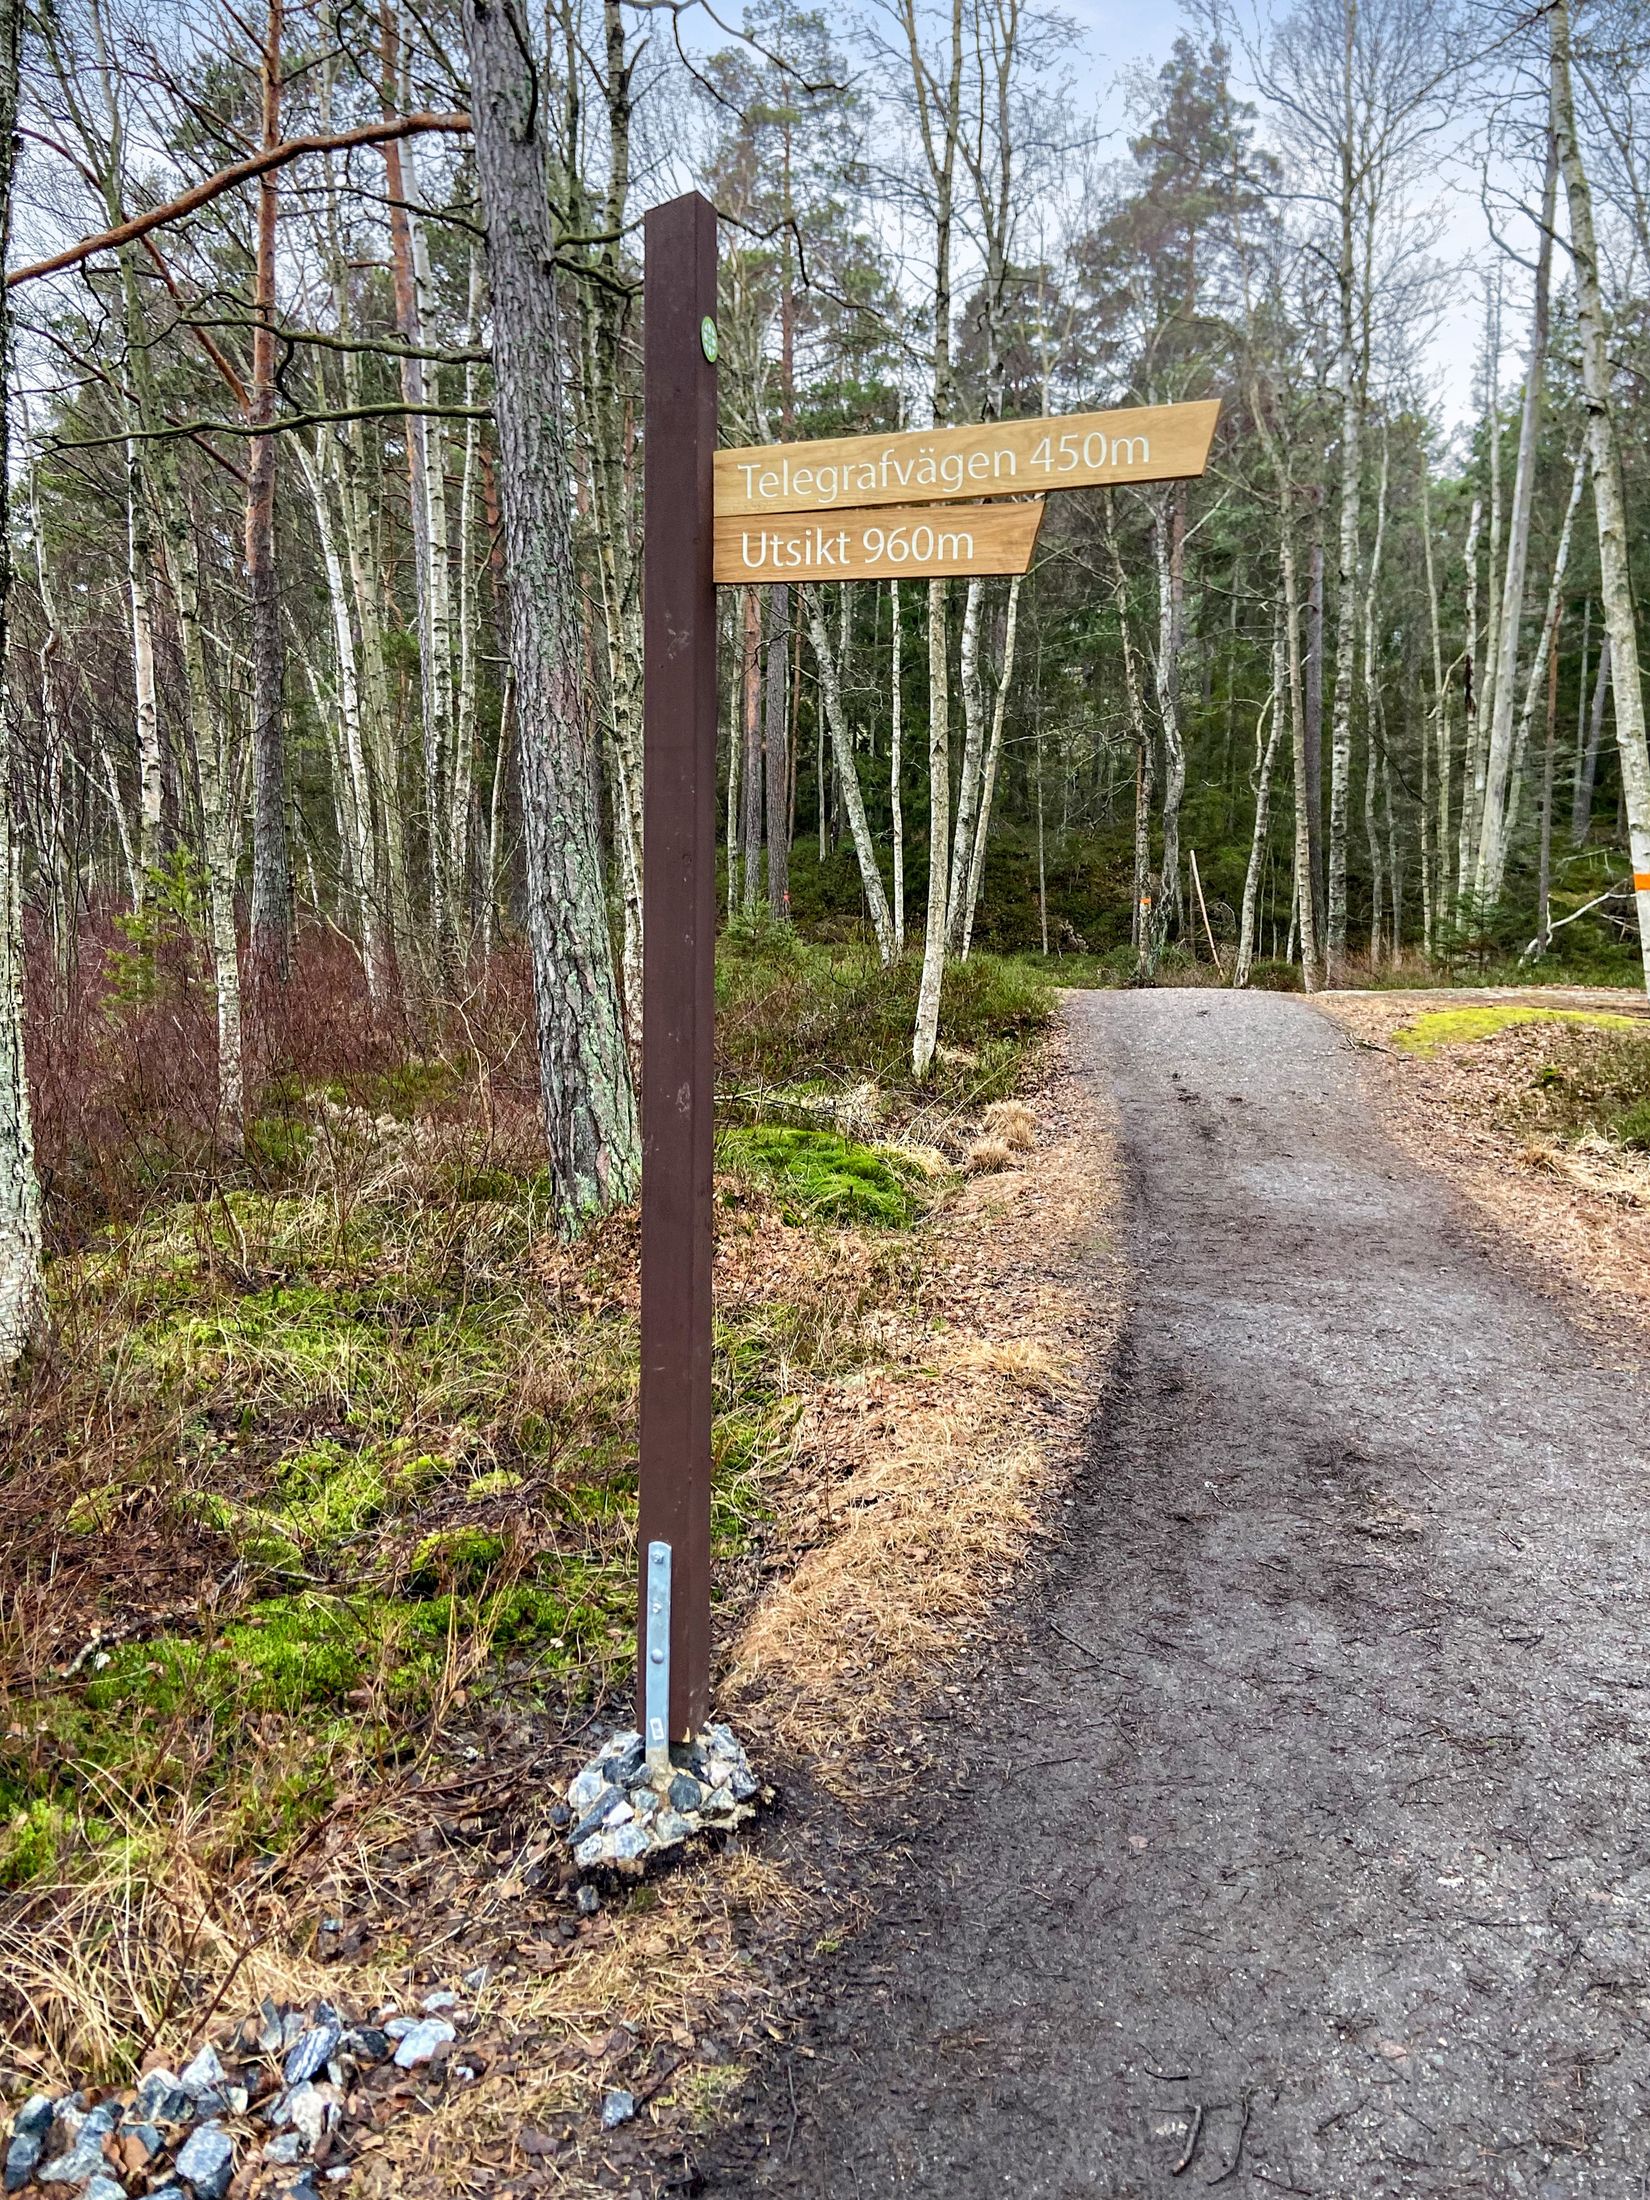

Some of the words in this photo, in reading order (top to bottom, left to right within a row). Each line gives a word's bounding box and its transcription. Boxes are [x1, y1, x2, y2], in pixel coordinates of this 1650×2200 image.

[737, 449, 1017, 502] Telegrafvägen
[1030, 431, 1150, 473] 450m
[741, 528, 850, 568] Utsikt
[863, 525, 974, 564] 960m
